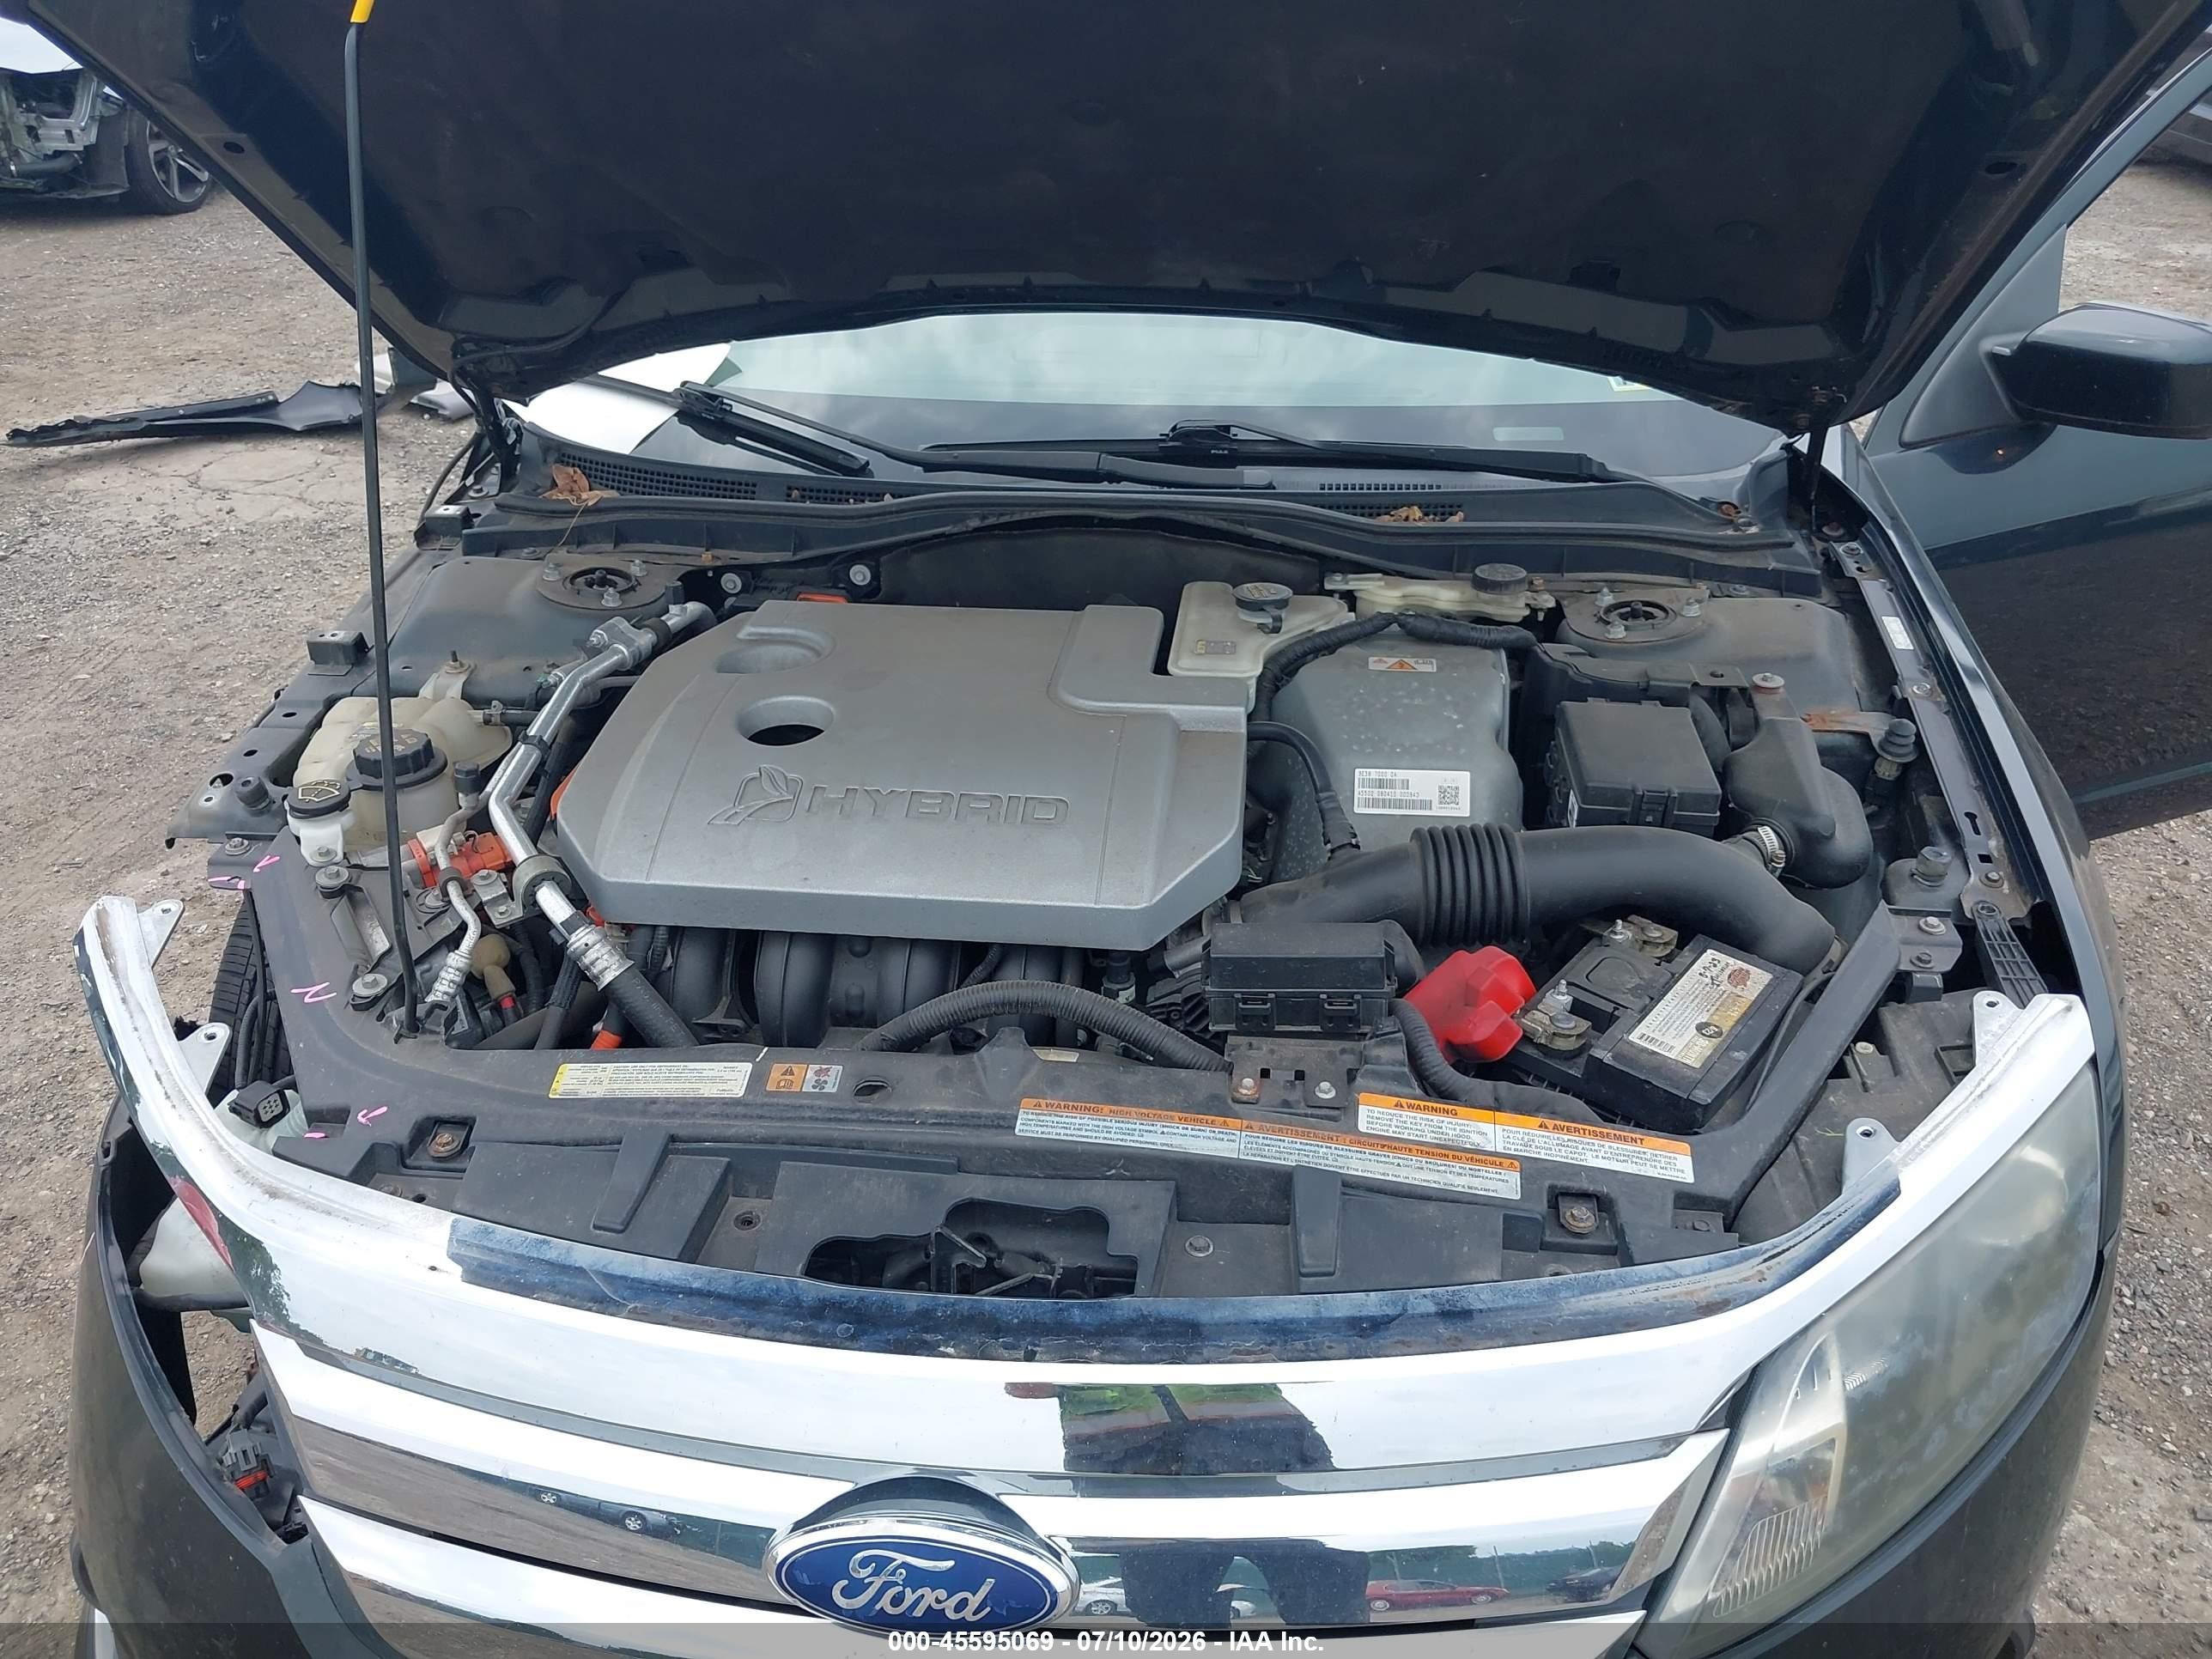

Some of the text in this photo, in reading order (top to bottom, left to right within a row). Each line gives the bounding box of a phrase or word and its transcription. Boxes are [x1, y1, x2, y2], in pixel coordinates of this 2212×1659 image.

[806, 784, 1071, 824] HYBRID
[1044, 1102, 1103, 1113] WARNING:
[1134, 1111, 1174, 1120] VOLTAGE
[1178, 1115, 1216, 1124] VEHICLE
[1406, 1102, 1457, 1116] WARNING
[1366, 1114, 1393, 1123] REMOVE
[1460, 1127, 1487, 1136] IGNITION
[1366, 1120, 1391, 1128] BEFORE
[1394, 1124, 1425, 1133] WORKING
[1551, 1122, 1645, 1145] AVERTISSEMENT
[1258, 1124, 1340, 1142] AVERTISSEMENT
[1387, 1144, 1413, 1153] HAUTE
[1415, 1148, 1449, 1158] TENSION
[1464, 1155, 1503, 1166] VÉHICULE
[1513, 1147, 1541, 1156] MARCHE
[1566, 1138, 1595, 1147] RISQUES
[1649, 1152, 1677, 1161] RETIRER
[1581, 1146, 1602, 1154] AVANT
[1601, 1155, 1628, 1164] MOTEUR
[1659, 1165, 1685, 1174] METTRE
[832, 1548, 996, 1622] Ford
